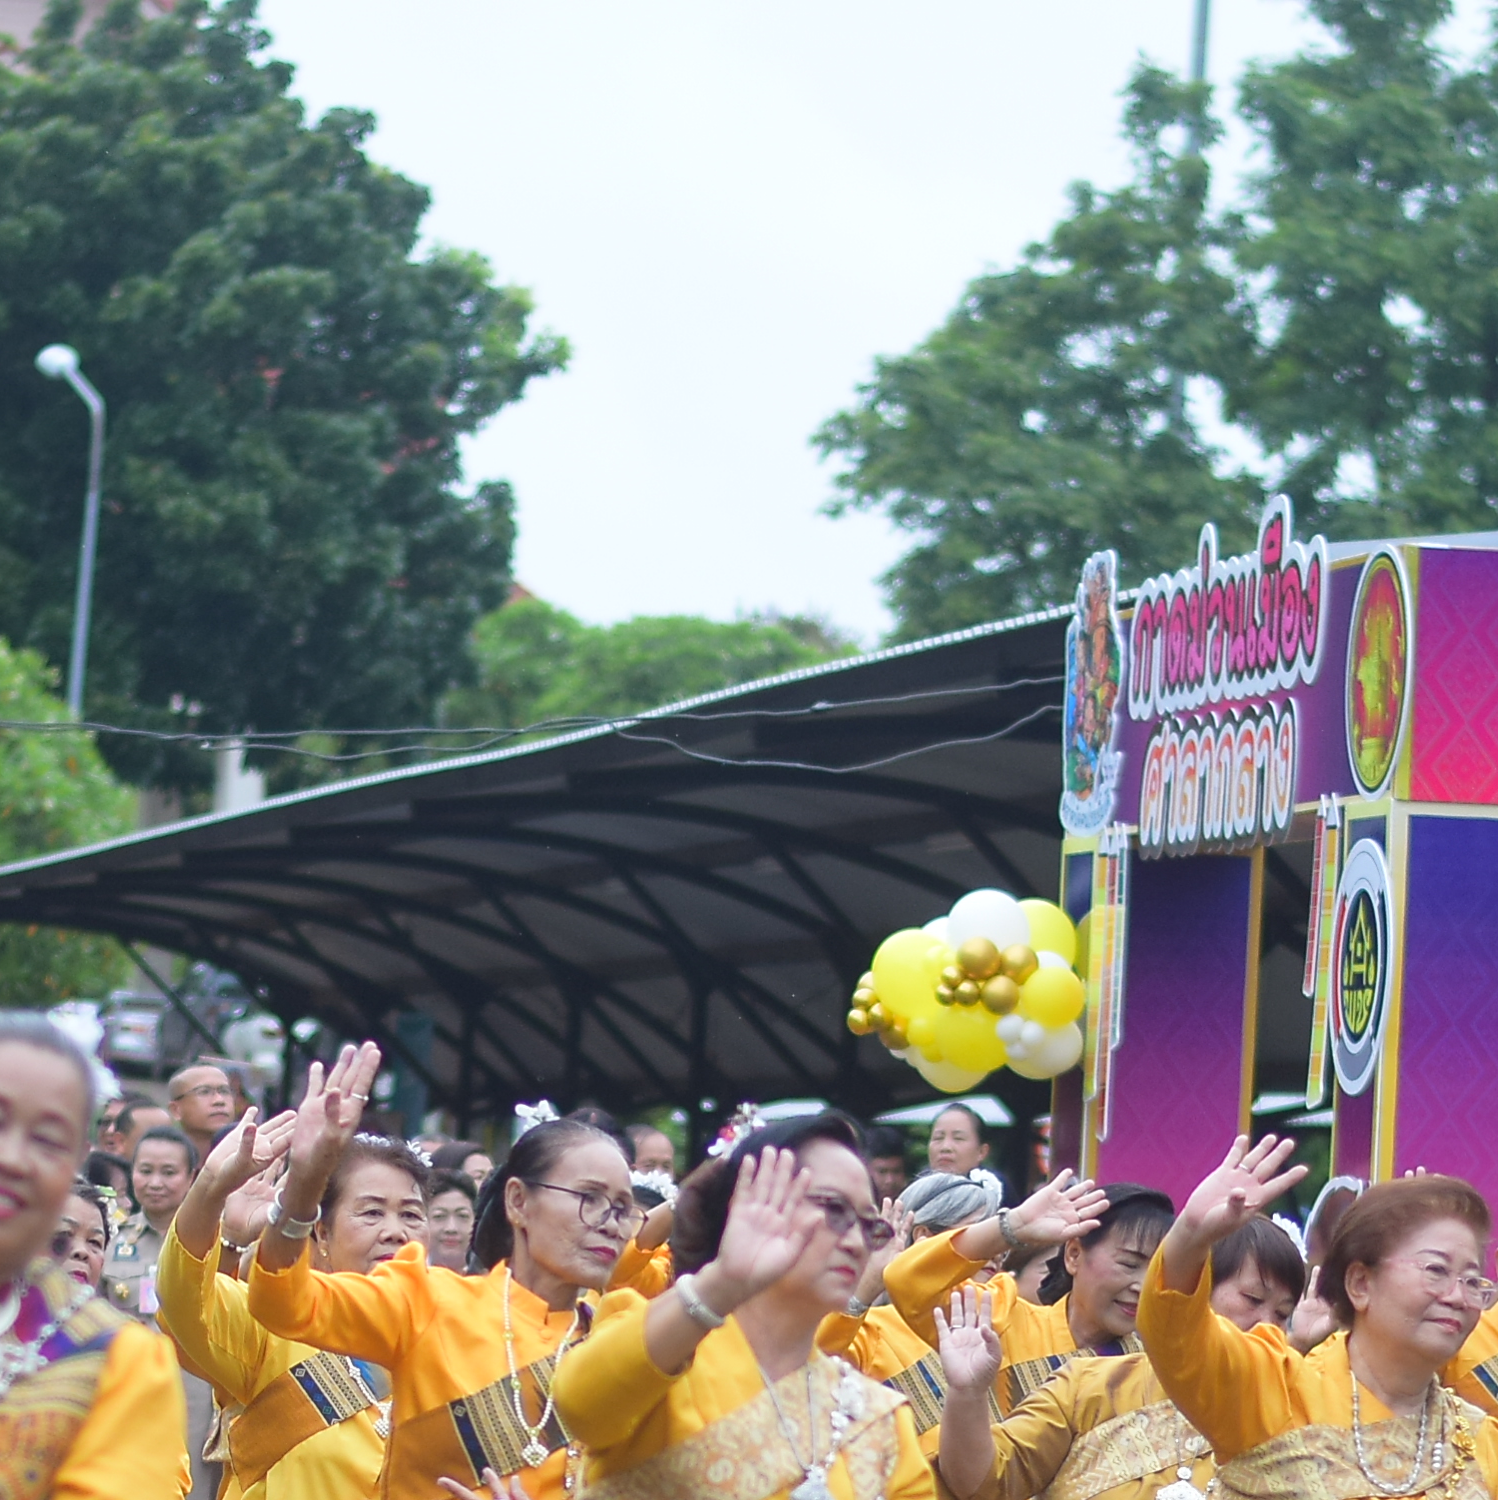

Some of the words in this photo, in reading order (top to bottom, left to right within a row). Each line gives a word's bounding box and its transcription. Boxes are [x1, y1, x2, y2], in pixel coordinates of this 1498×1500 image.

[1131, 510, 1321, 705] กาดม่วนเมือง
[1139, 720, 1295, 844] ศาลากลาง
